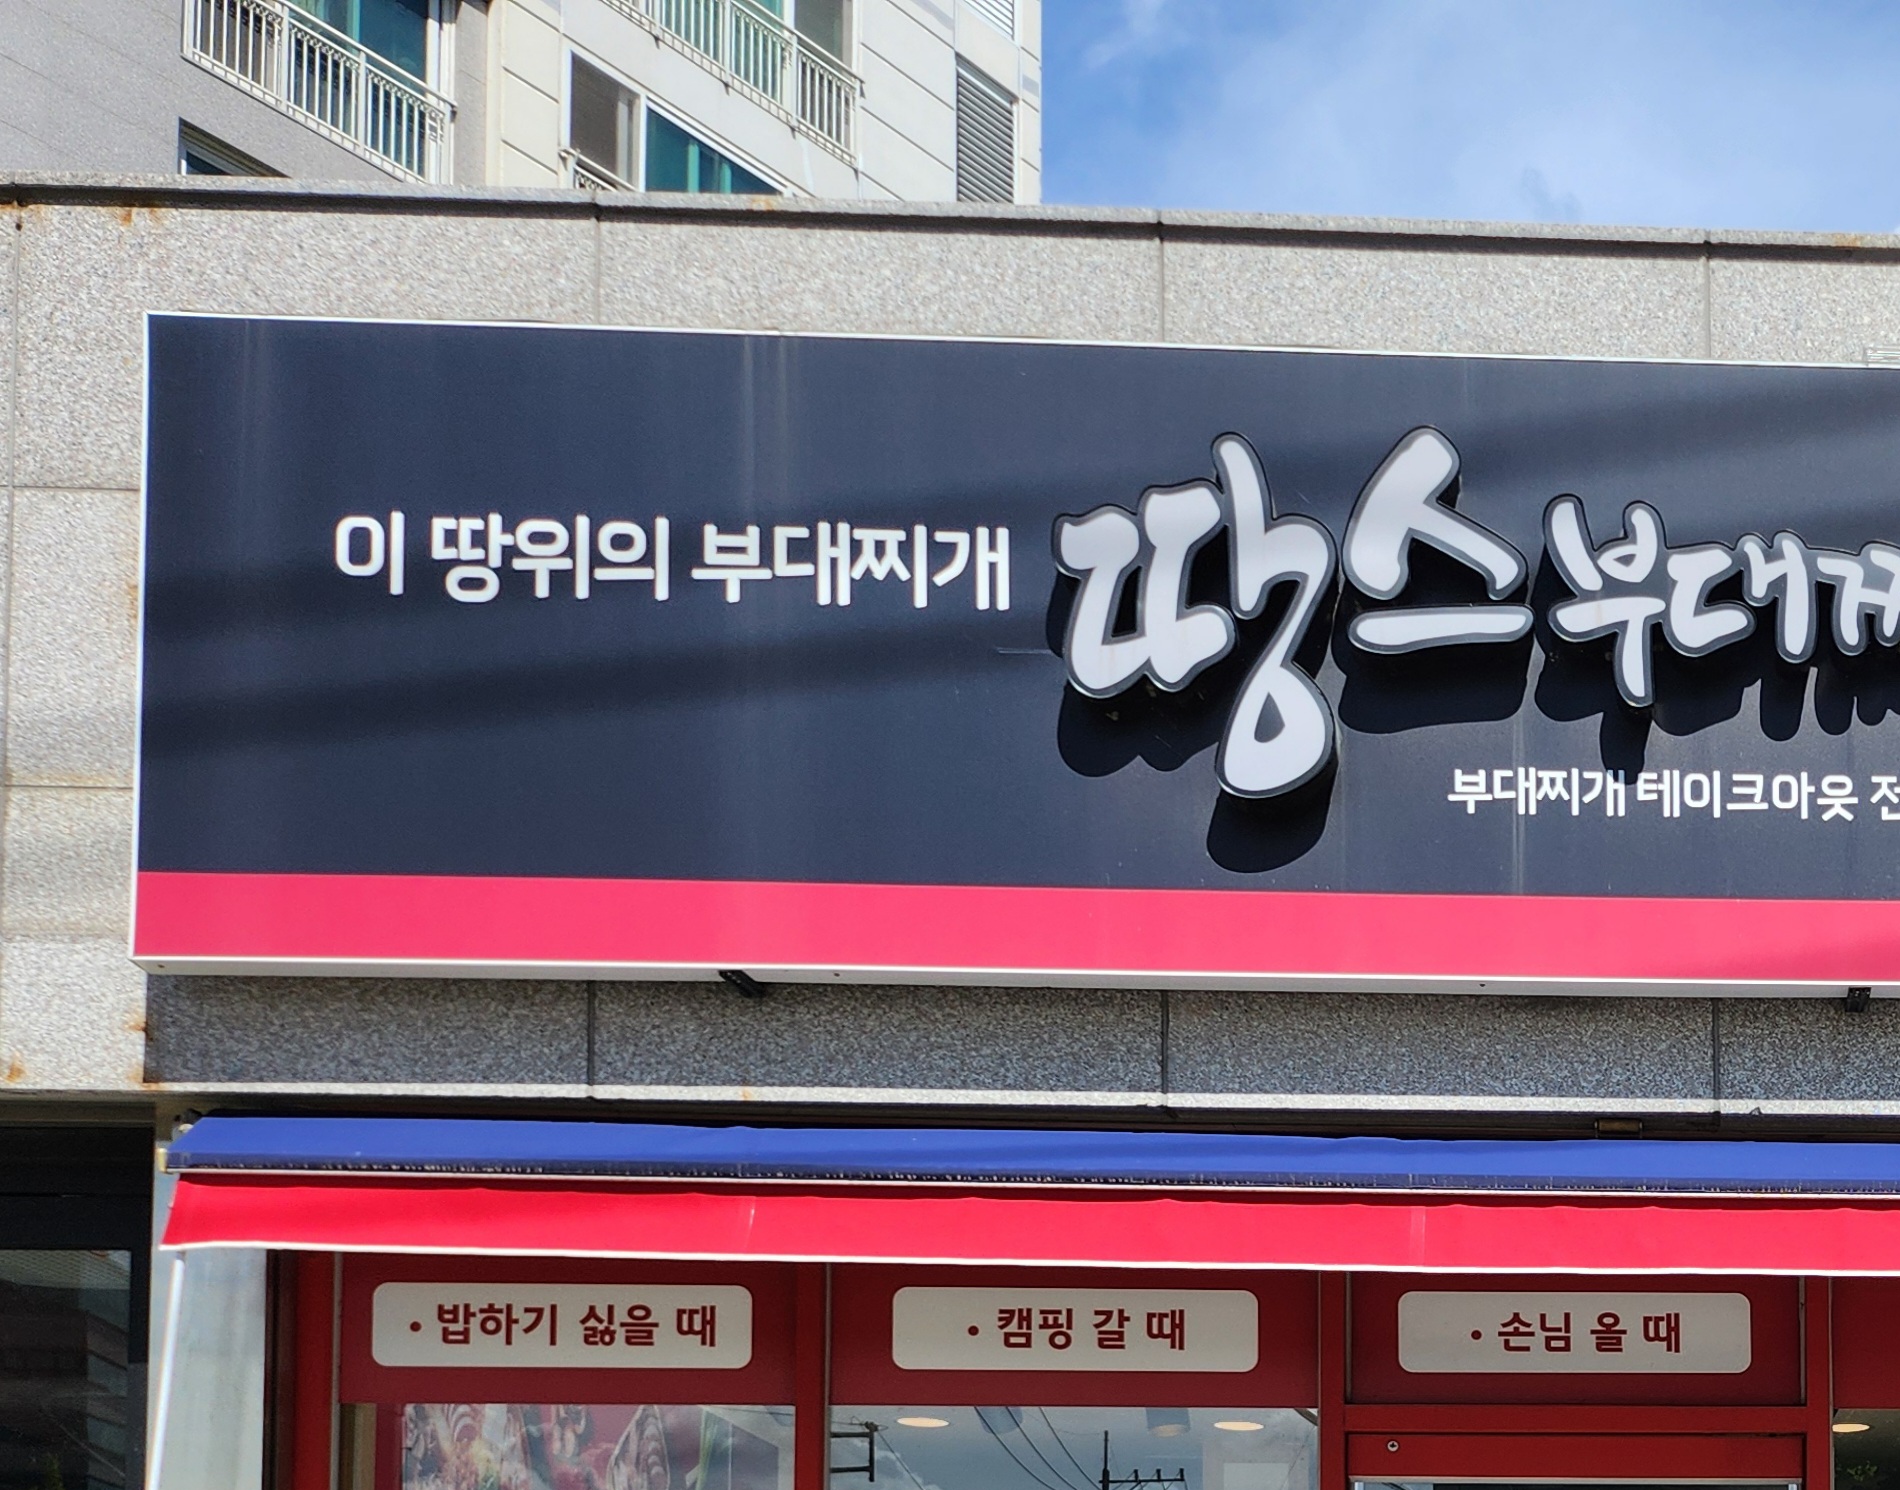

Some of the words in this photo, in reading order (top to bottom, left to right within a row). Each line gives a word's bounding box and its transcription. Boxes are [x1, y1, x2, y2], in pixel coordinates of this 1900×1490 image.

[334, 510, 405, 595] 이
[430, 512, 670, 603] 땅위의
[690, 520, 1011, 611] 부대찌개
[1448, 768, 1626, 816] 부대찌개
[1636, 770, 1860, 822] 테이크아웃
[435, 1301, 561, 1347] 밥하기
[579, 1302, 660, 1349] 싫을
[675, 1303, 719, 1350] 때
[996, 1305, 1075, 1352] 캠핑
[1090, 1307, 1131, 1351] 갈
[1145, 1307, 1187, 1352] 때
[1497, 1311, 1574, 1355] 손님
[1589, 1312, 1628, 1355] 올
[1642, 1311, 1683, 1356] 때
